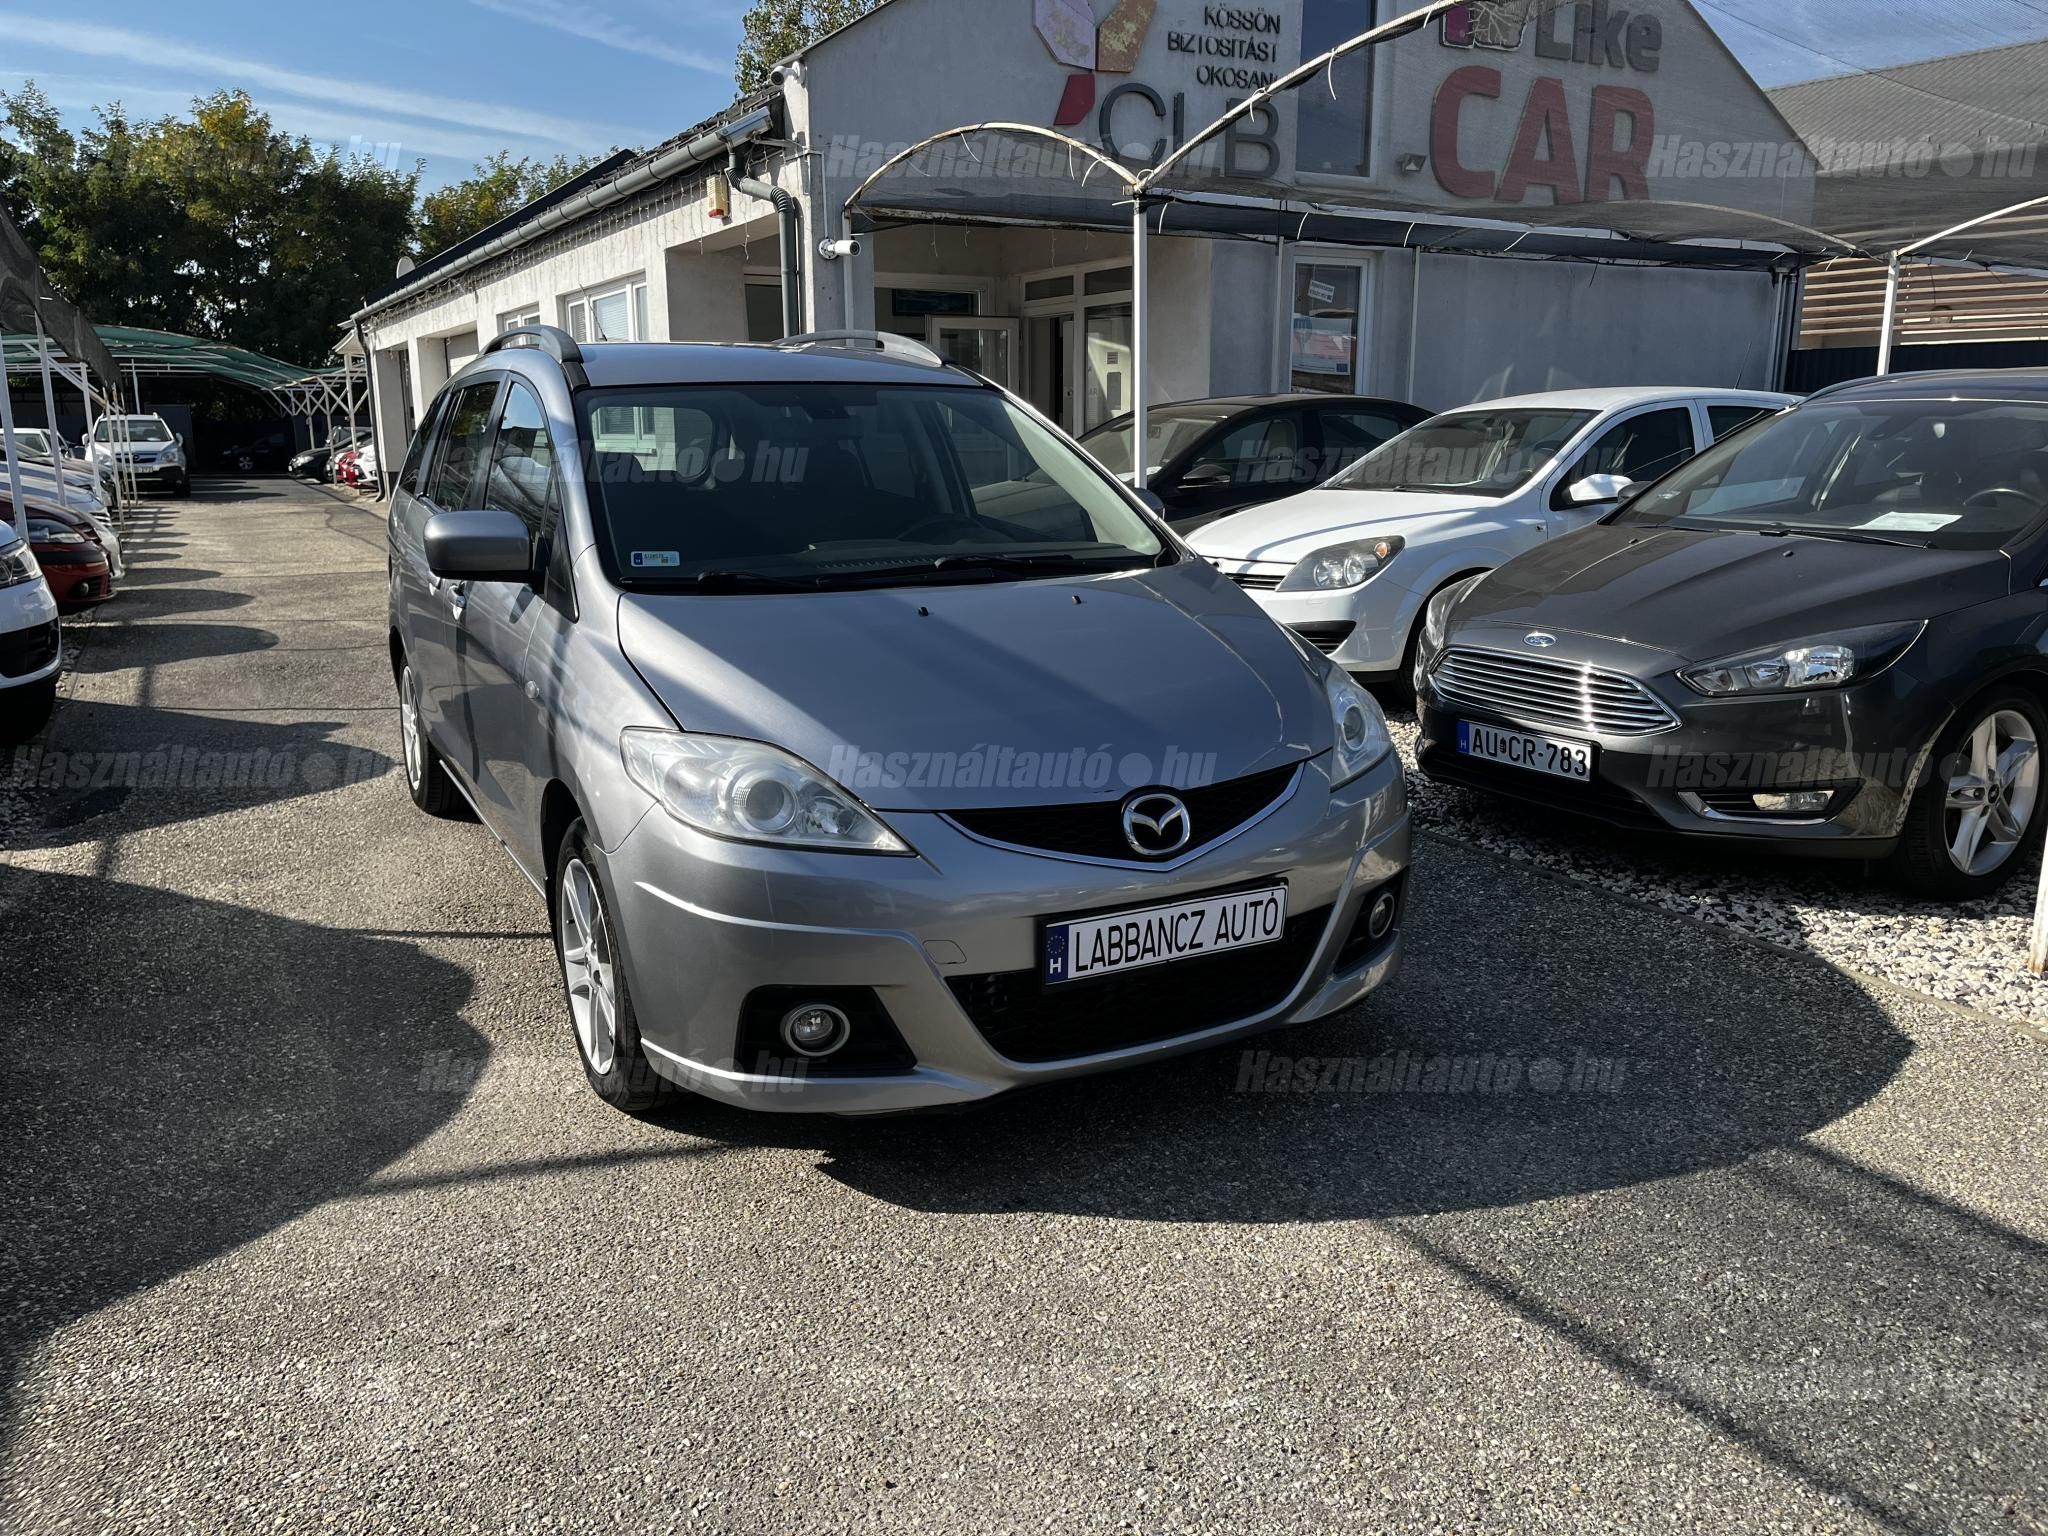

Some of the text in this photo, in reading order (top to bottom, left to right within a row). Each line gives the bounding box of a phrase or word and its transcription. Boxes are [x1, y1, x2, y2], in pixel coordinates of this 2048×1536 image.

[1204, 3, 1281, 34] KÖSSÖN
[1534, 0, 1662, 72] Like
[1196, 64, 1278, 89] OKOSAN
[1430, 64, 1655, 204] CAR
[1508, 735, 1587, 777] CR-783
[1075, 892, 1279, 972] LABBANCZ AUTÓ
[1049, 957, 1062, 974] H
